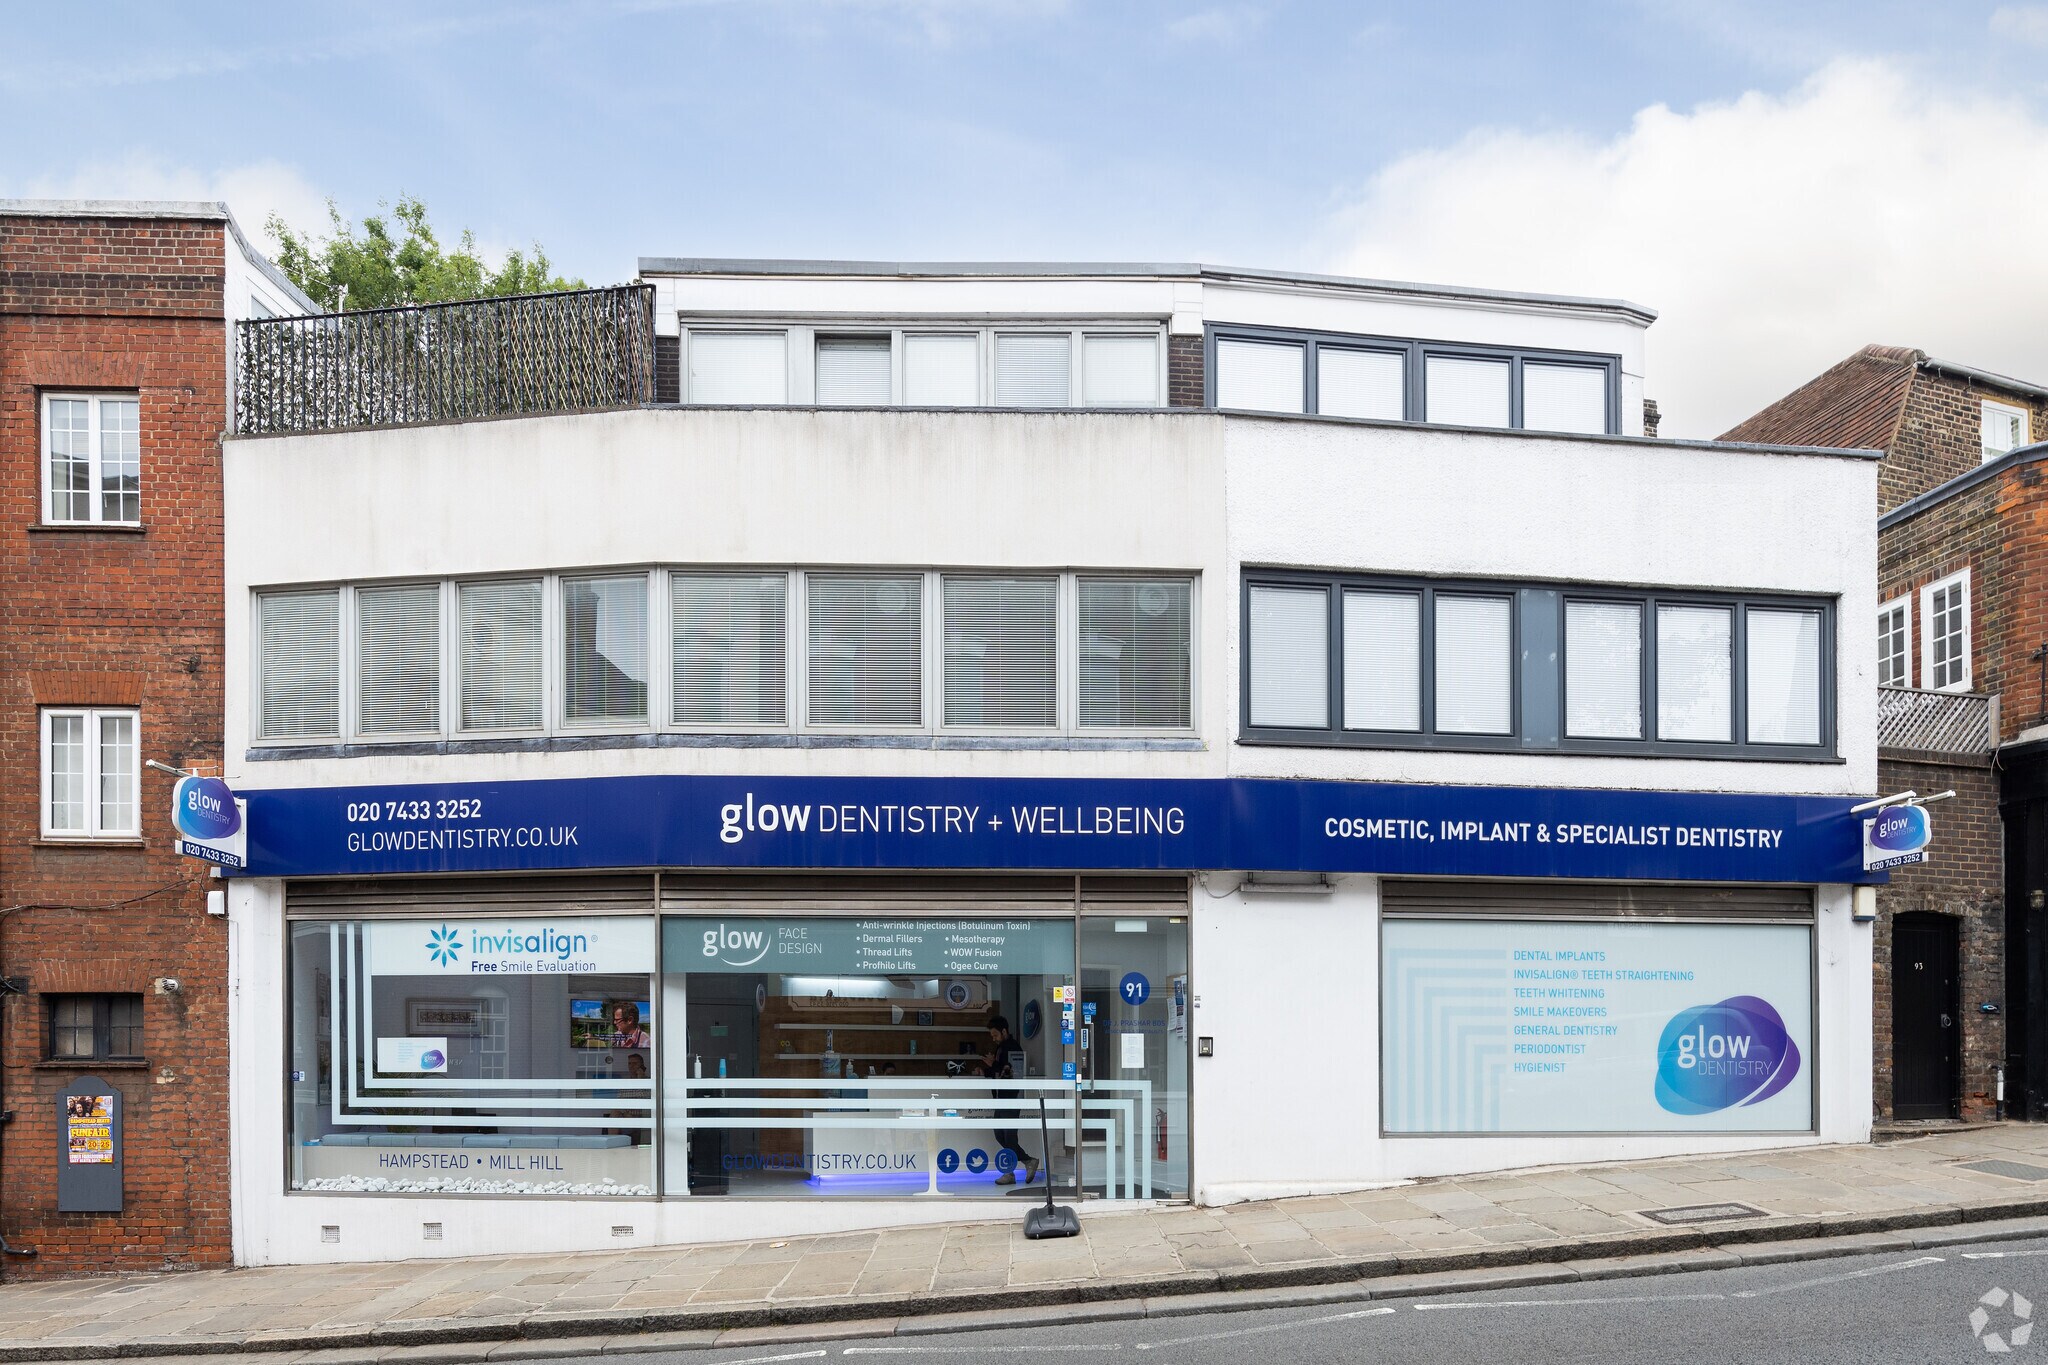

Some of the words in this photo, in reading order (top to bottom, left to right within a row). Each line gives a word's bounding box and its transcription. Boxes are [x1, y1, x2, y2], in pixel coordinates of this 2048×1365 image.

[188, 788, 221, 812] glow
[197, 807, 230, 825] DENTISTRY
[347, 802, 380, 822] 020
[385, 800, 431, 821] 7433
[435, 798, 482, 819] 3252
[719, 792, 812, 844] glow
[819, 805, 980, 833] DENTISTRY
[987, 814, 1003, 831] +
[1011, 806, 1184, 835] WELLBEING
[1325, 817, 1435, 843] COSMETIC,
[1441, 820, 1532, 842] IMPLANT
[1536, 823, 1551, 843] &
[1556, 824, 1671, 846] SPECIALIST
[1676, 827, 1783, 849] DENTISTRY
[1879, 818, 1909, 838] glow
[1887, 826, 1917, 839] DENTISTRY
[347, 826, 578, 852] GLOWDENTISTRY.CO.UK
[185, 843, 200, 856] 020
[201, 847, 220, 861] 7433
[220, 853, 239, 867] 3252
[1871, 861, 1884, 871] 020
[1885, 857, 1902, 868] 7433
[1902, 853, 1920, 864] 3252
[862, 922, 914, 930] Anti-wrinkle
[916, 922, 957, 931] Injections
[958, 922, 1004, 930] (Botulinum
[1006, 922, 1031, 930] Toxin)
[778, 927, 808, 939] FACE
[862, 933, 895, 943] Dermal
[895, 934, 923, 943] Fillers
[702, 923, 763, 957] glow
[951, 935, 1006, 945] Mesotherapy
[778, 942, 822, 954] DESIGN
[863, 948, 892, 956] Thread
[893, 947, 913, 957] Lifts
[950, 948, 973, 957] WOW
[974, 948, 1002, 957] Fusion
[1513, 950, 1553, 961] DENTAL
[1555, 951, 1606, 962] IMPLANTS
[471, 960, 498, 972] Free
[500, 960, 533, 973] Smile
[536, 960, 597, 972] Evaluation
[862, 960, 896, 970] Profhilo
[897, 960, 917, 970] Lifts
[950, 961, 972, 972] Ogee
[973, 961, 999, 970] Curve
[1914, 962, 1924, 971] 93
[1581, 969, 1613, 980] TEETH
[1615, 970, 1694, 981] STRAIGHTENING
[1125, 982, 1142, 998] 91
[1513, 987, 1546, 998] TEETH
[1547, 988, 1605, 999] WHITENING
[1513, 1006, 1545, 1017] SMILE
[1547, 1006, 1607, 1017] MAKEOVERS
[1513, 1025, 1561, 1036] GENERAL
[1563, 1025, 1618, 1036] DENTISTRY
[1514, 1043, 1586, 1054] PERIODONTIST
[1677, 1024, 1751, 1069] glow
[424, 1054, 438, 1063] glow
[1514, 1062, 1566, 1073] HYGIENIST
[1698, 1060, 1773, 1076] DENTISTRY
[71, 1128, 109, 1138] FUNFAIR
[379, 1153, 469, 1169] HAMPSTEAD
[490, 1154, 526, 1170] MILL
[529, 1155, 564, 1171] HILL
[721, 1153, 917, 1171] GLOWDENTISTRY.CO.UK
